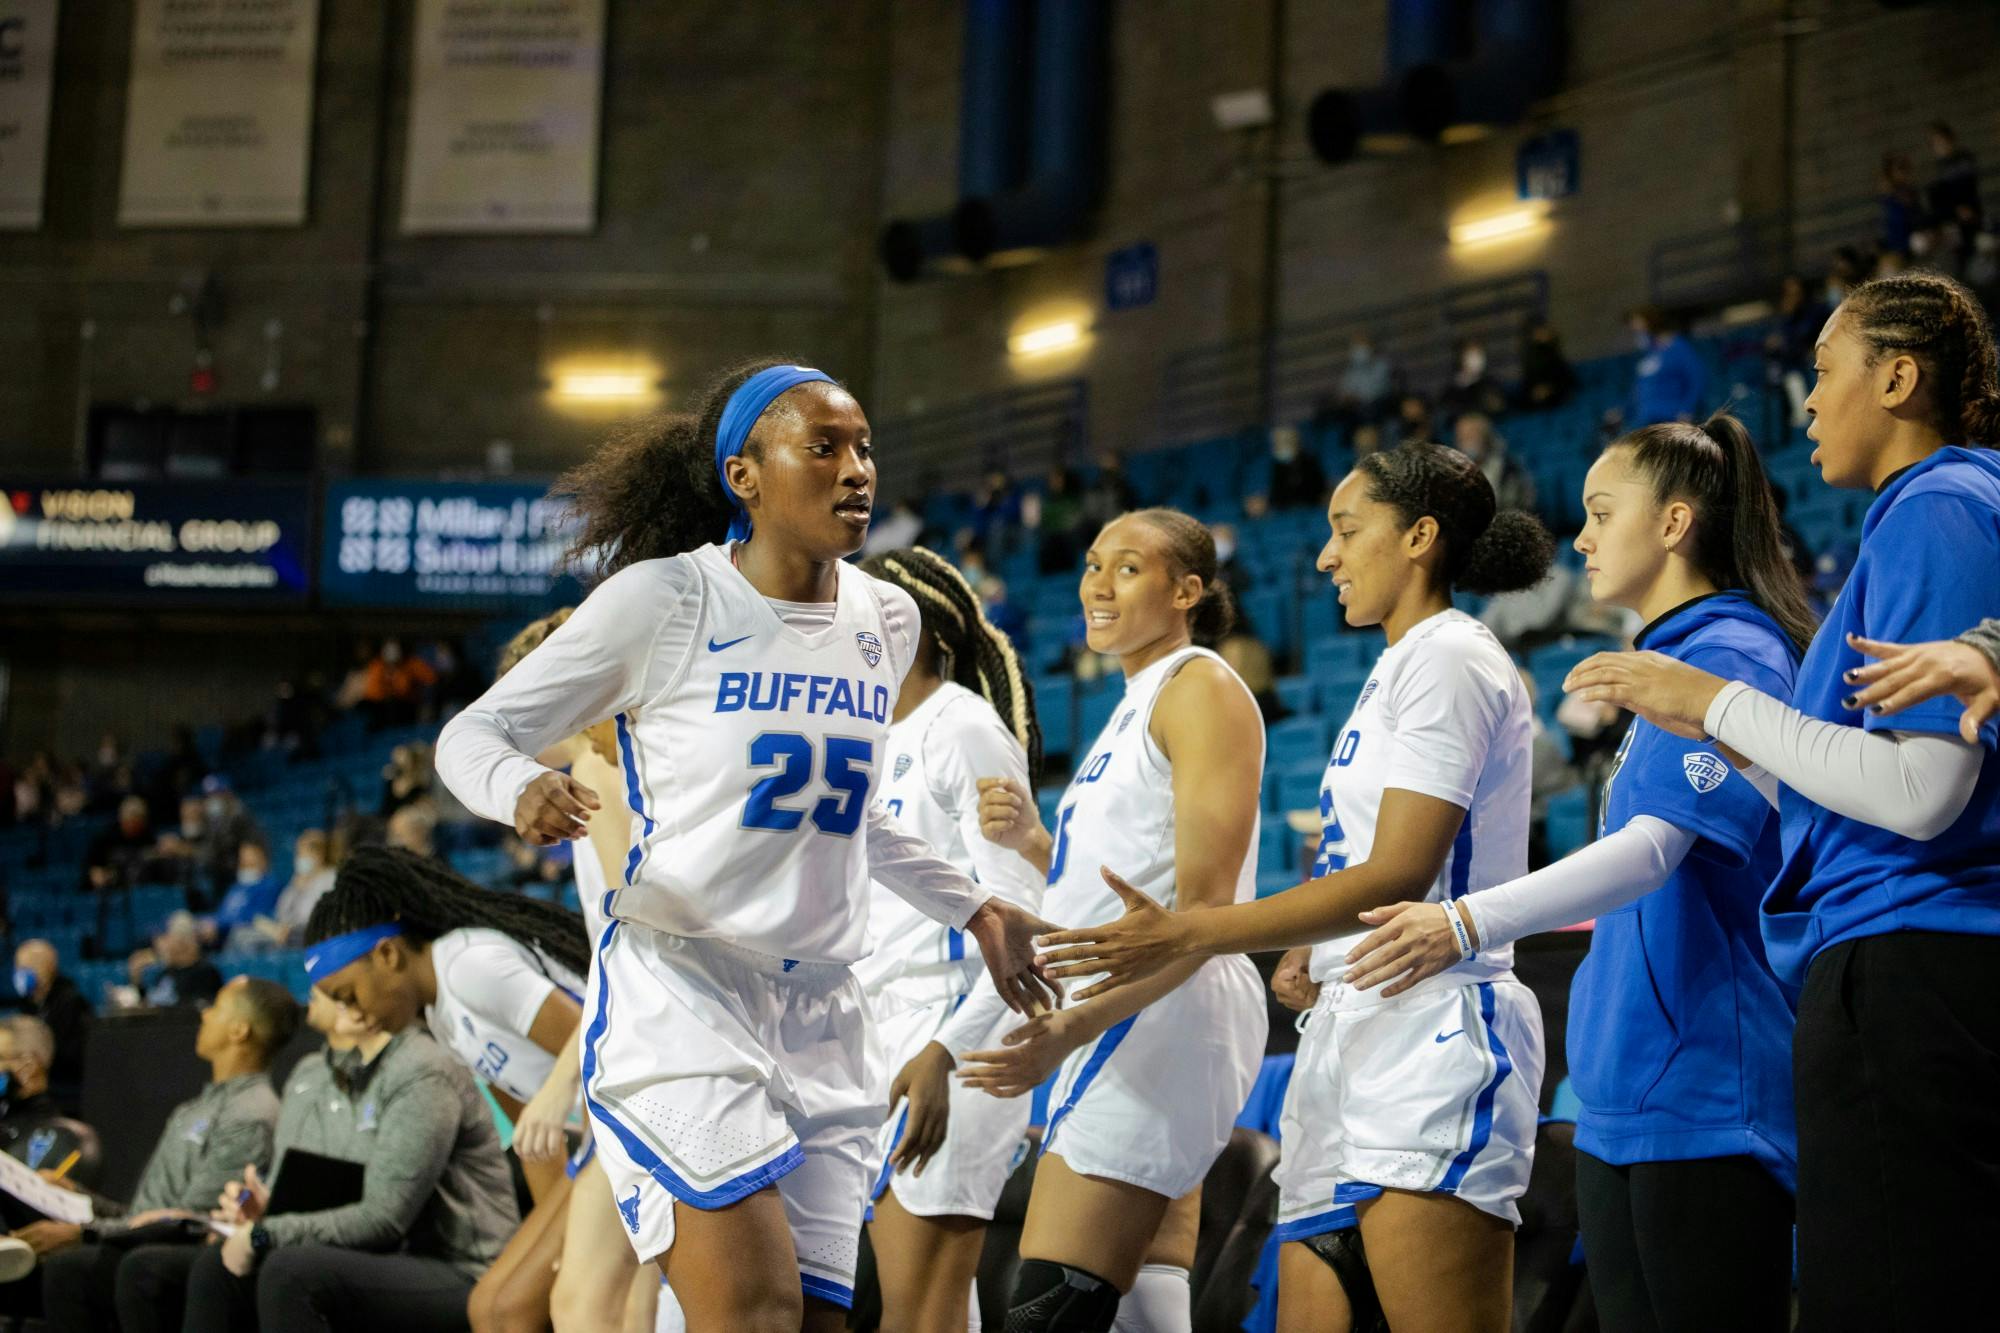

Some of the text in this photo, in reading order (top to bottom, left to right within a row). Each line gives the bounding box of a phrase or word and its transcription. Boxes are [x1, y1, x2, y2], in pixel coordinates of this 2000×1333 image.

[41, 489, 135, 521] VISION
[36, 520, 281, 552] FINANCIAL GROUP
[713, 672, 888, 725] BUFFALO
[737, 730, 875, 840] 25
[1685, 762, 1723, 784] MAC
